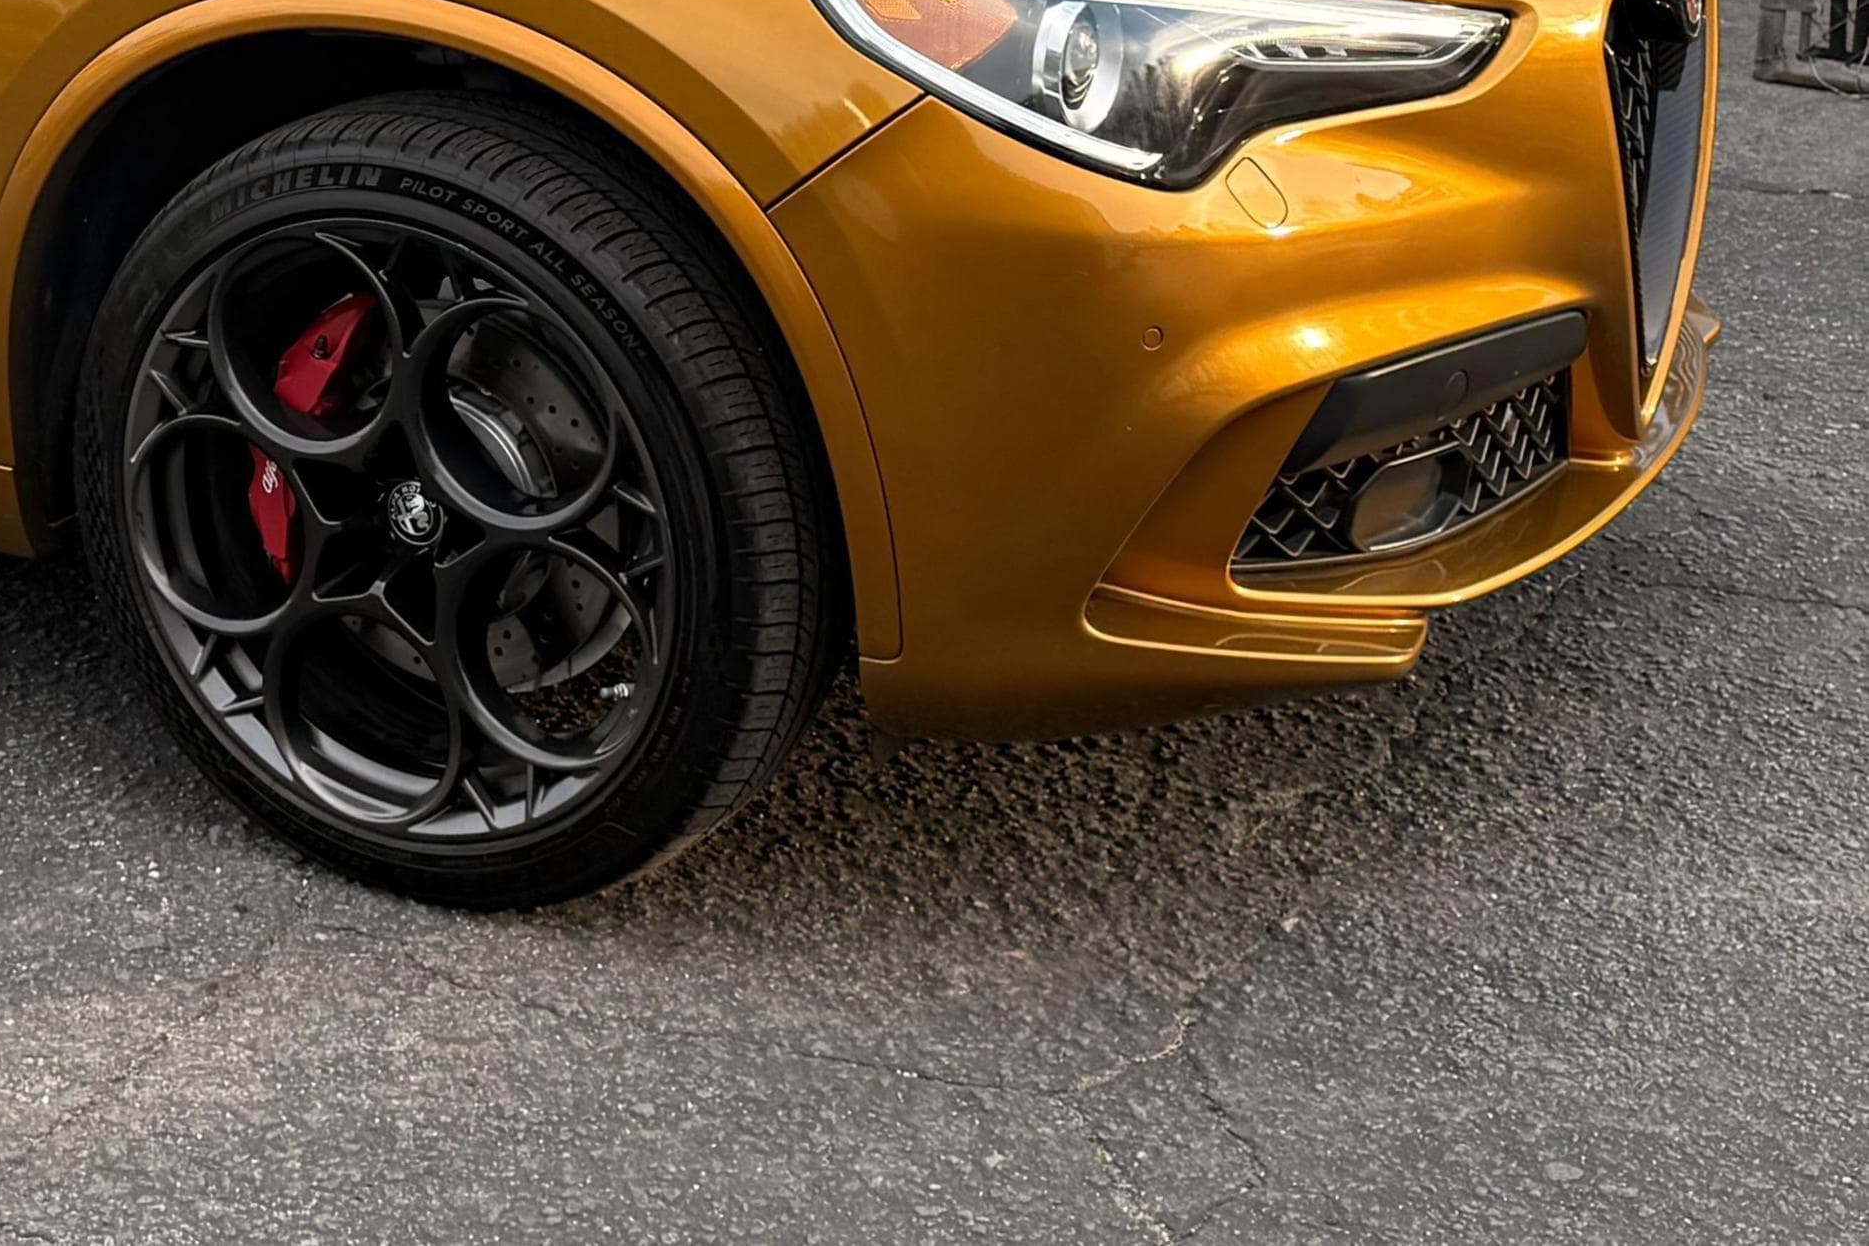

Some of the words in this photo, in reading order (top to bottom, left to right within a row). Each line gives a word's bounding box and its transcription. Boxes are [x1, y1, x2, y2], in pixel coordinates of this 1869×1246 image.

[210, 165, 381, 223] MICHELIN
[399, 177, 458, 202] PILOT
[461, 198, 529, 239] SPORT
[529, 241, 566, 272] ALL
[570, 274, 641, 348] SEASON
